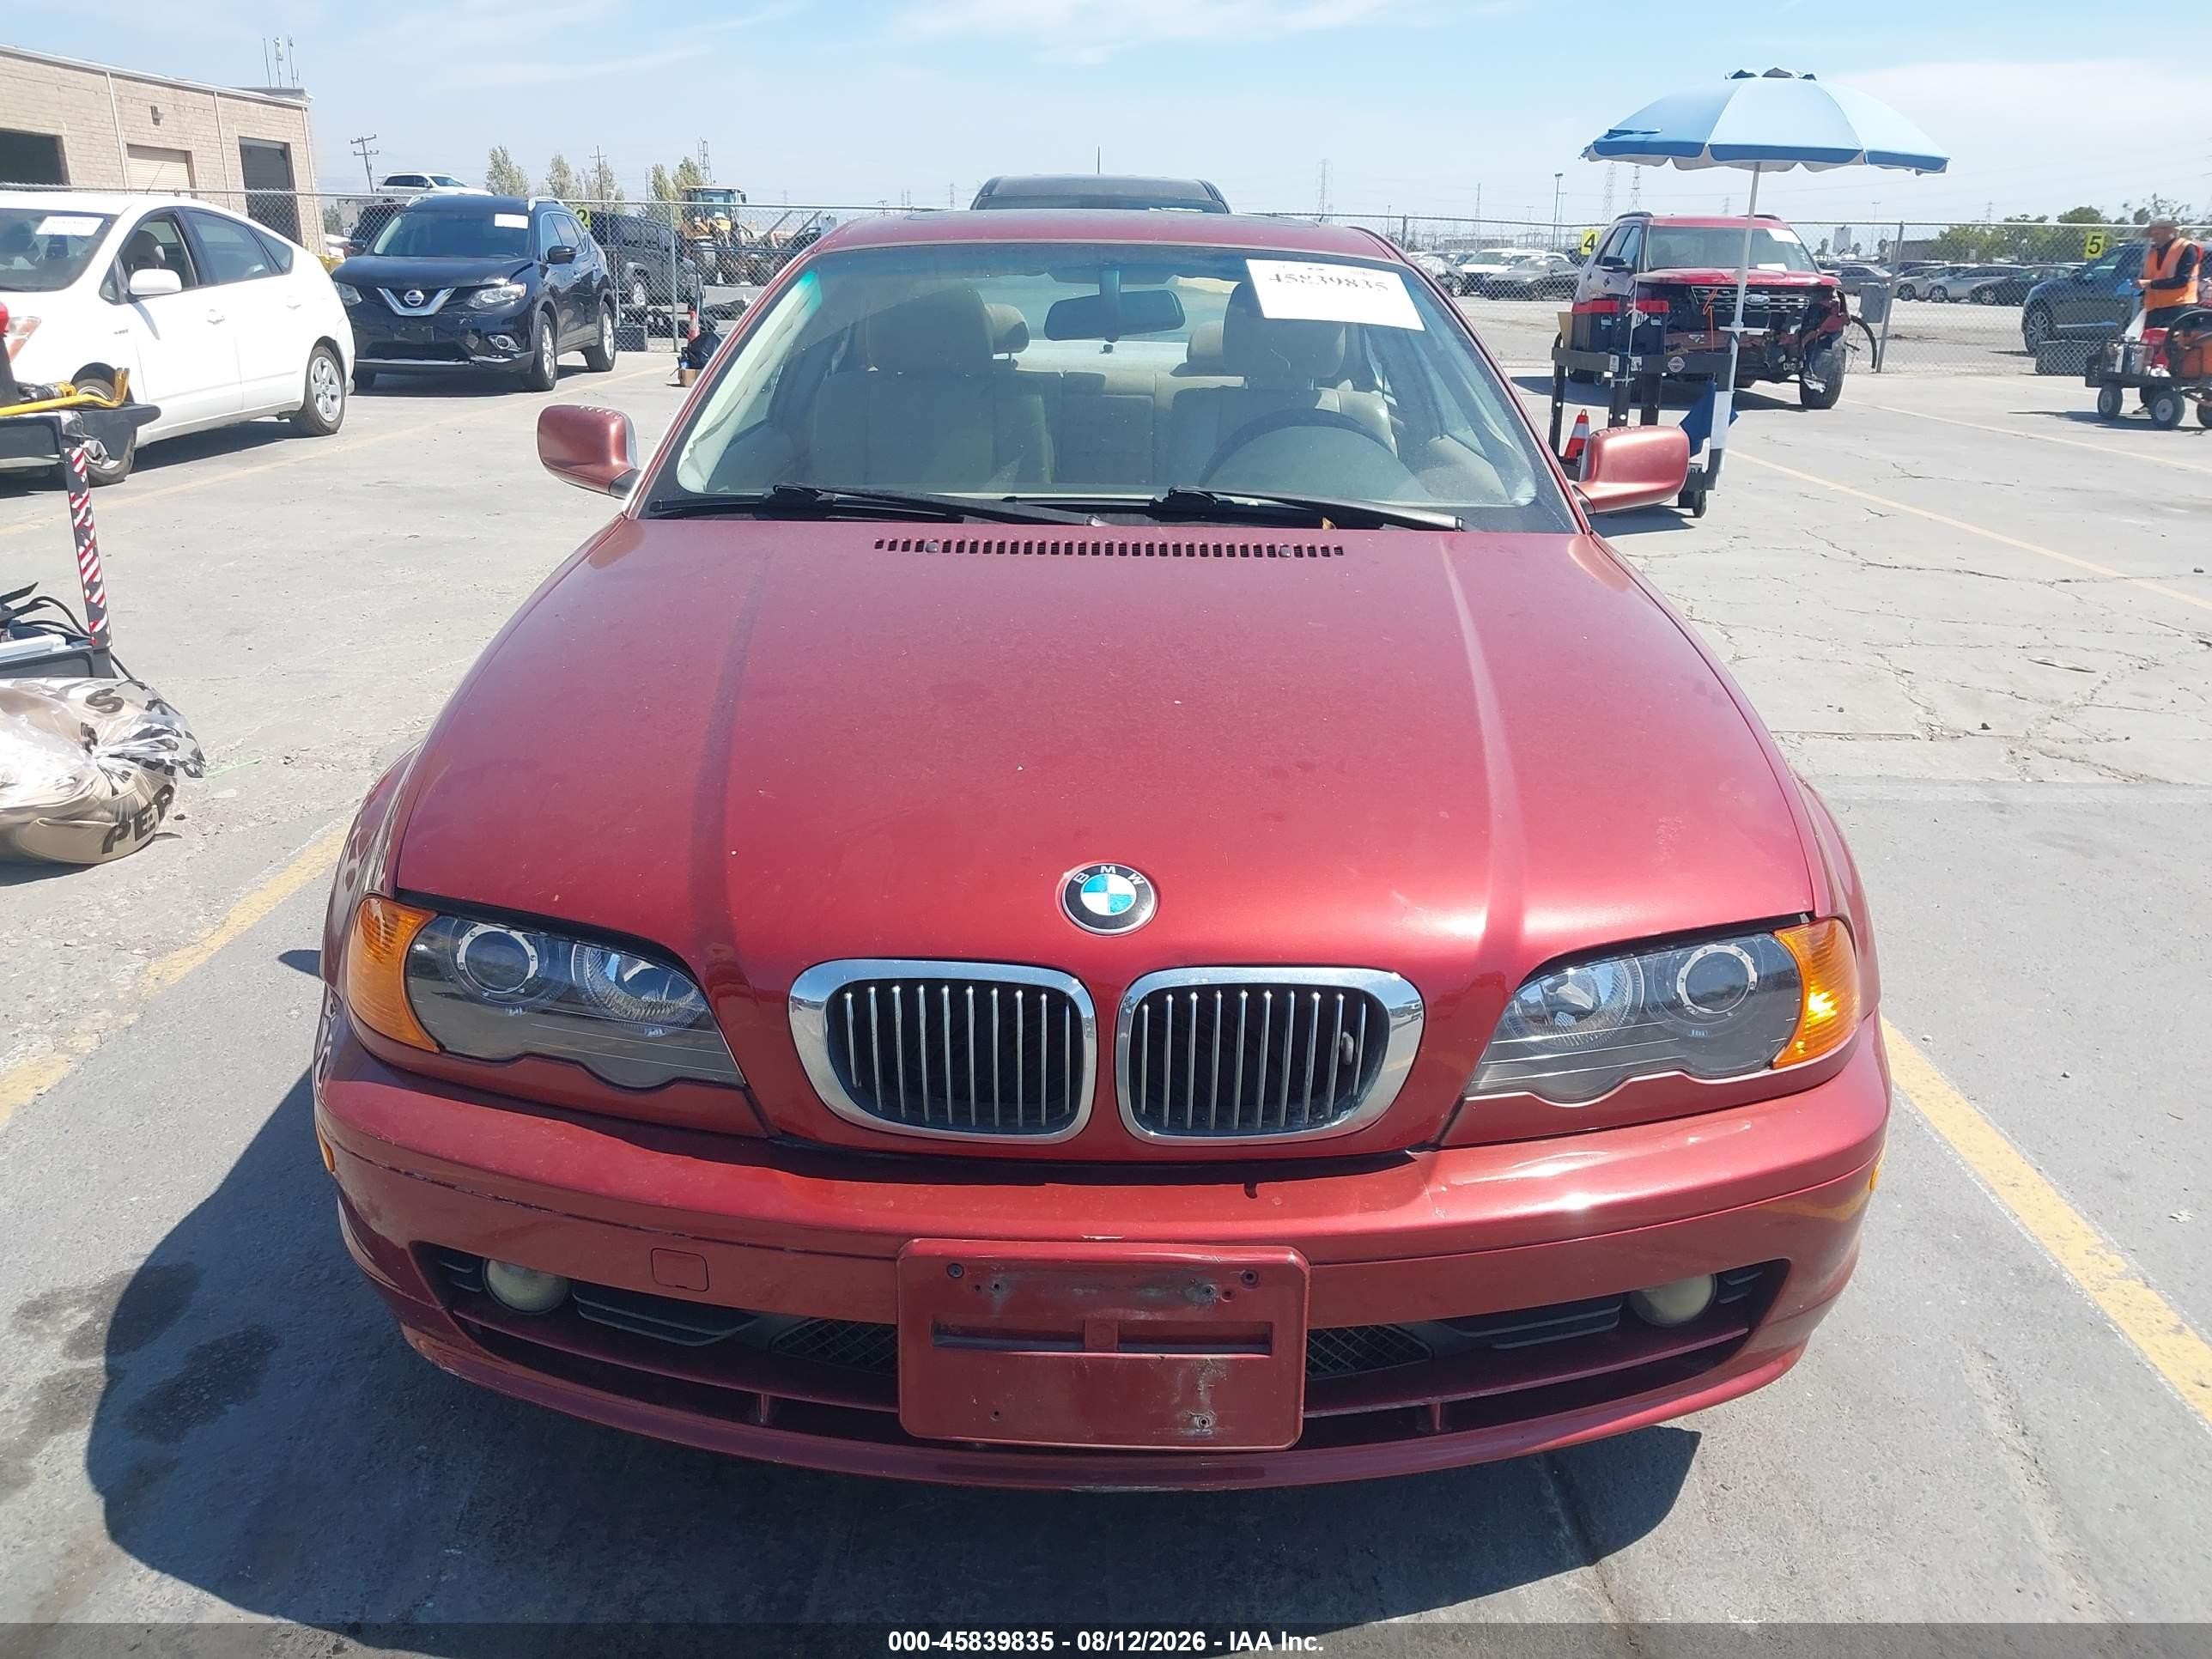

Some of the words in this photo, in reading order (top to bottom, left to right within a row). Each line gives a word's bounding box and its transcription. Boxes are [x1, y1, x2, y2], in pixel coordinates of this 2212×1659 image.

[1584, 233, 1595, 252] 4
[2088, 235, 2102, 255] 5
[1073, 866, 1146, 885] BMW
